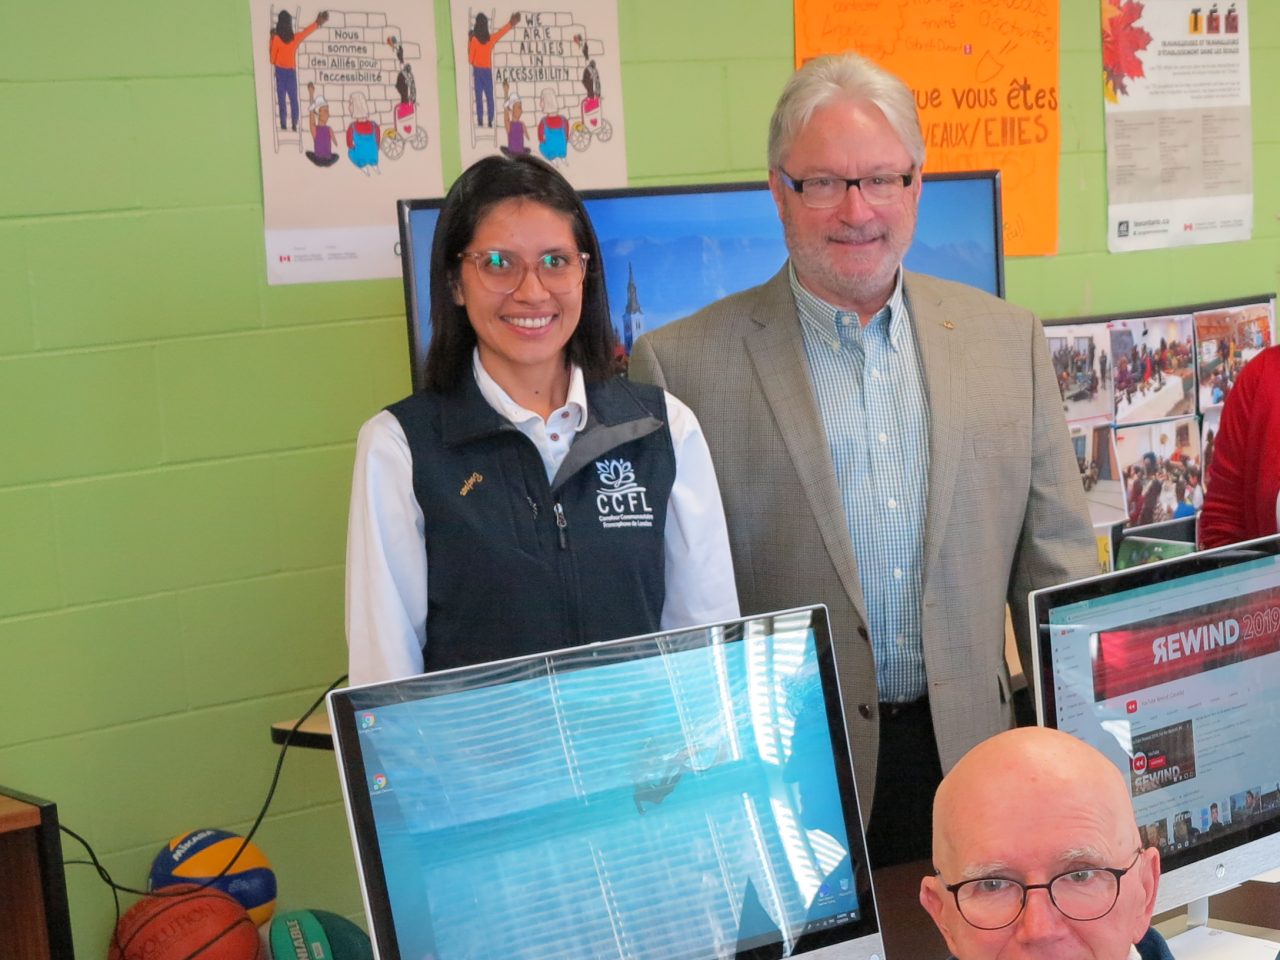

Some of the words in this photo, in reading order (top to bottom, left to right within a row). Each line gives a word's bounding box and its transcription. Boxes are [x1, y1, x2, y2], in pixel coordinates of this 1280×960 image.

[526, 13, 542, 26] WE
[335, 30, 359, 40] Nous
[524, 27, 551, 40] ARE
[328, 44, 367, 54] sommes
[521, 42, 564, 56] ALLIES
[311, 57, 327, 66] des
[331, 57, 356, 68] Alliés
[360, 60, 378, 70] pour
[530, 55, 544, 66] IN
[320, 70, 383, 82] l'accessibilité
[496, 67, 569, 81] ACCESSIBILITY
[952, 87, 998, 109] vous
[1007, 77, 1058, 111] êtes
[597, 492, 653, 514] CCFL
